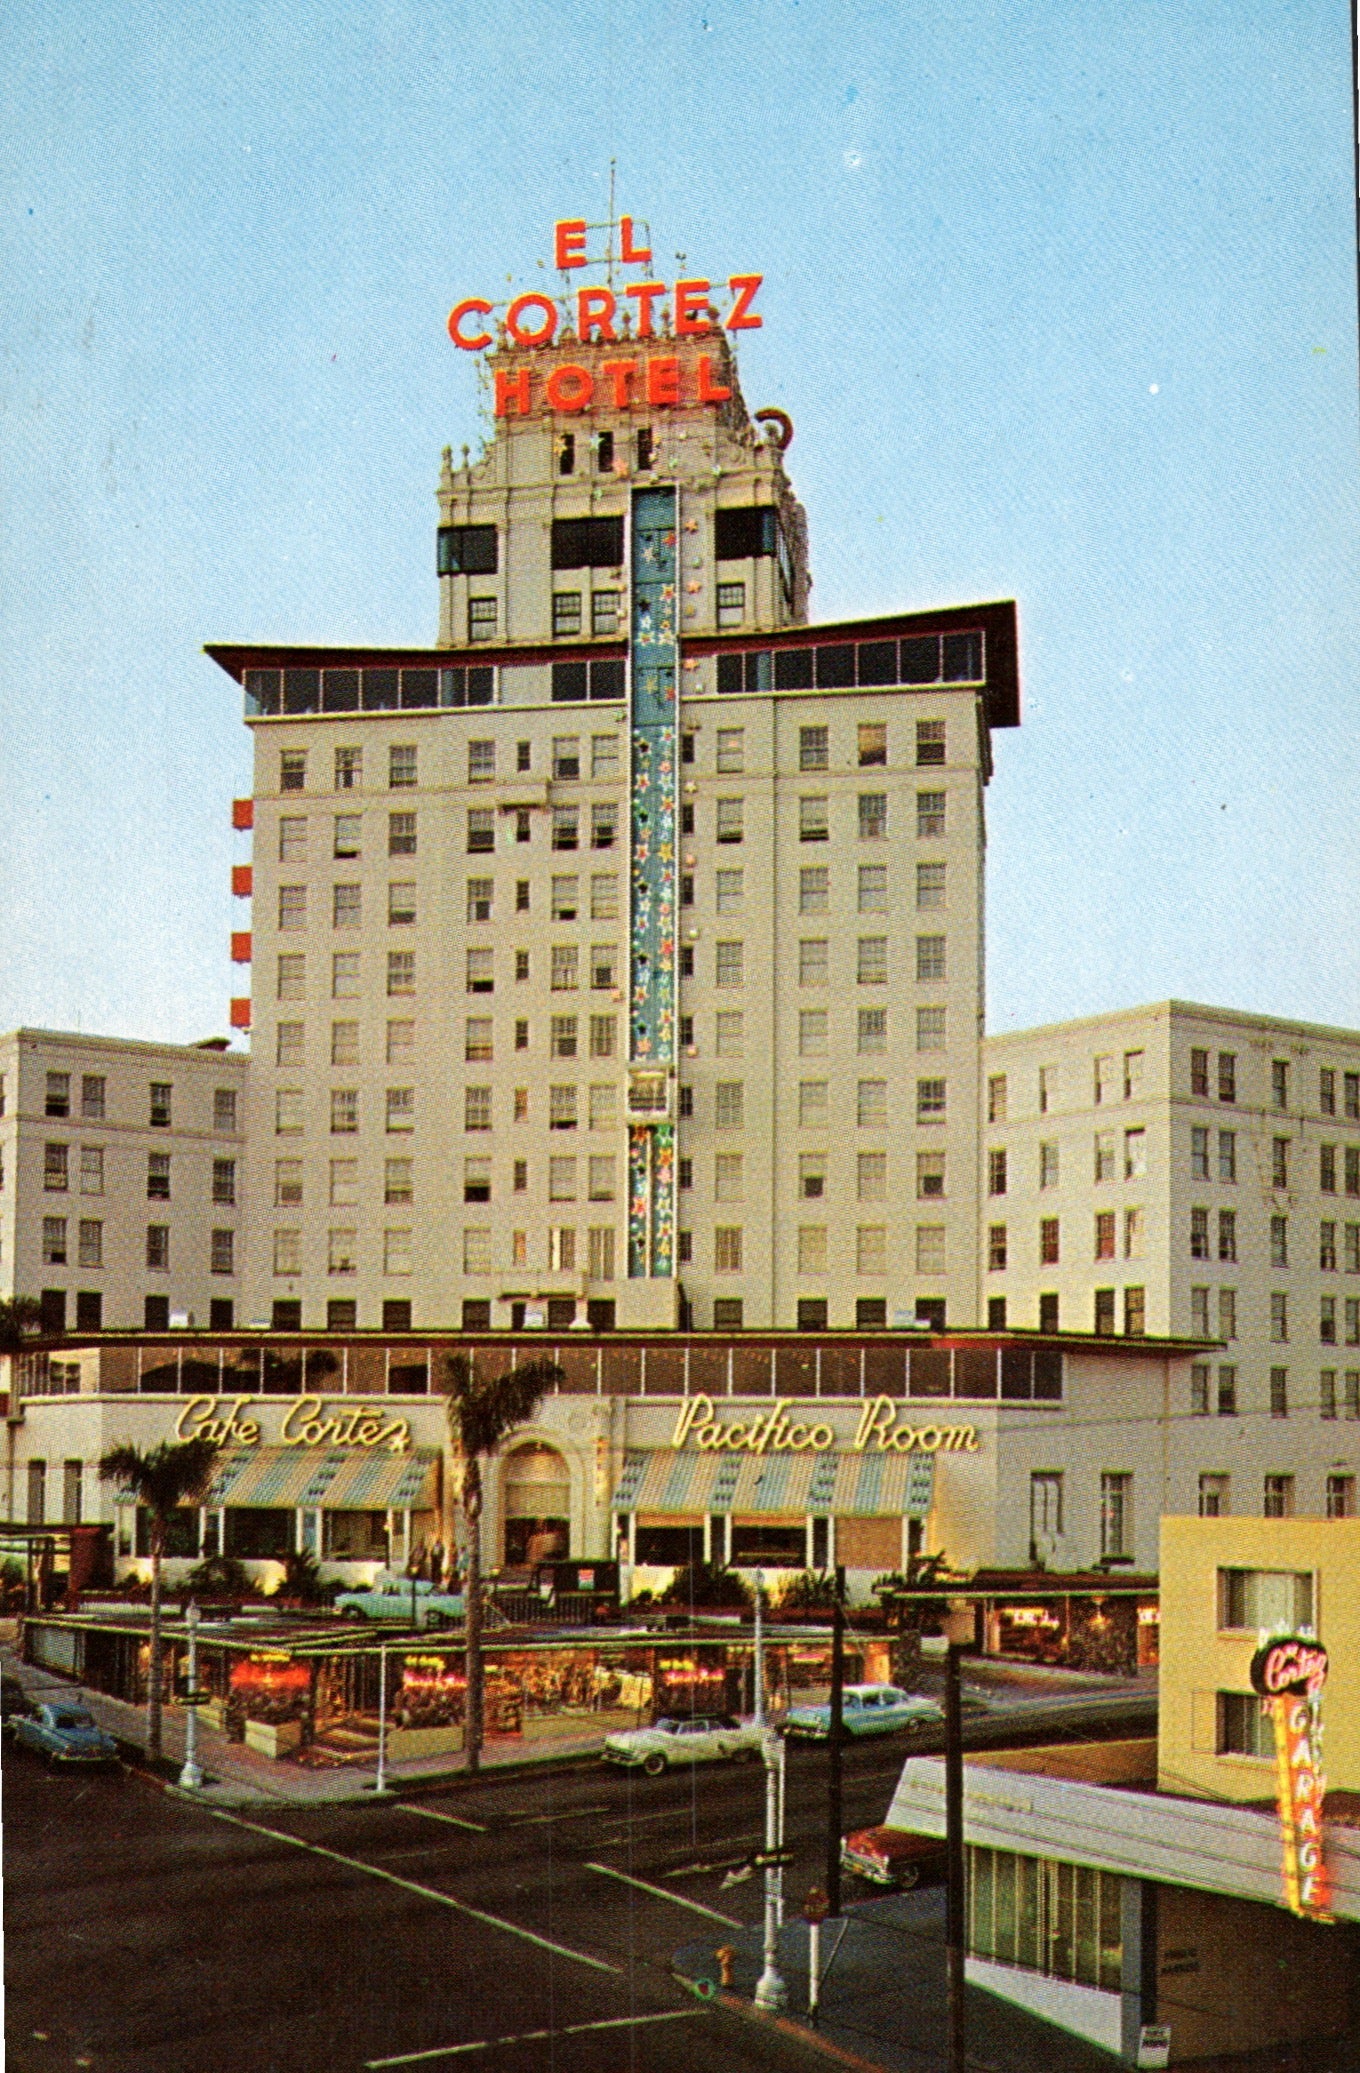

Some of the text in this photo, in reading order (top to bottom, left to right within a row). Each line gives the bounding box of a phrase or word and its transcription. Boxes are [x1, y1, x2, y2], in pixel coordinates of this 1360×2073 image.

[554, 215, 652, 269] EL
[447, 273, 763, 350] CORTEZ
[494, 353, 732, 417] HOTEL
[282, 1393, 411, 1454] Cortez
[673, 1394, 979, 1454] Pacifico Room
[1290, 1703, 1320, 1907] GARAGE
